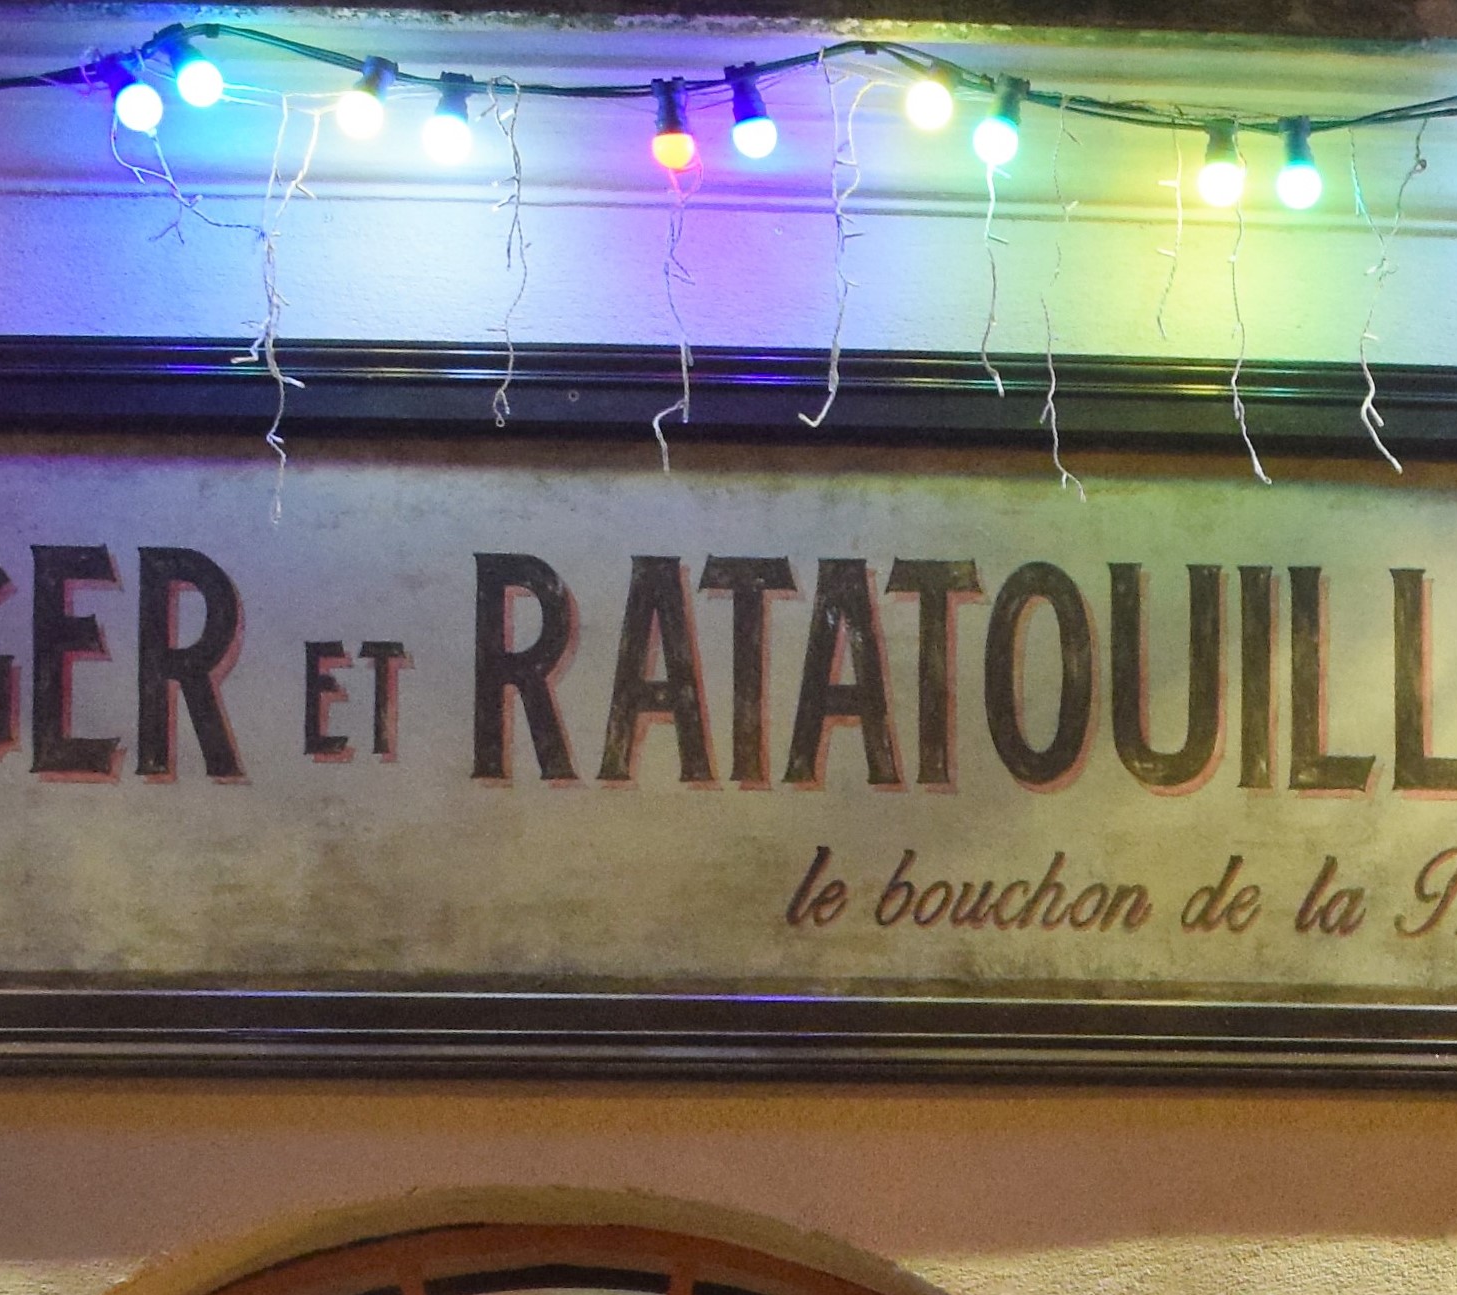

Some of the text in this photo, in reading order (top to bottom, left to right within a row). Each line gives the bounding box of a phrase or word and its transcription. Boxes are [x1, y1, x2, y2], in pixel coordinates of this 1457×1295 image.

[303, 639, 414, 763] ET
[786, 846, 846, 927] le
[874, 849, 1152, 935] bouchon
[1180, 855, 1264, 934] de
[1294, 854, 1366, 935] la
